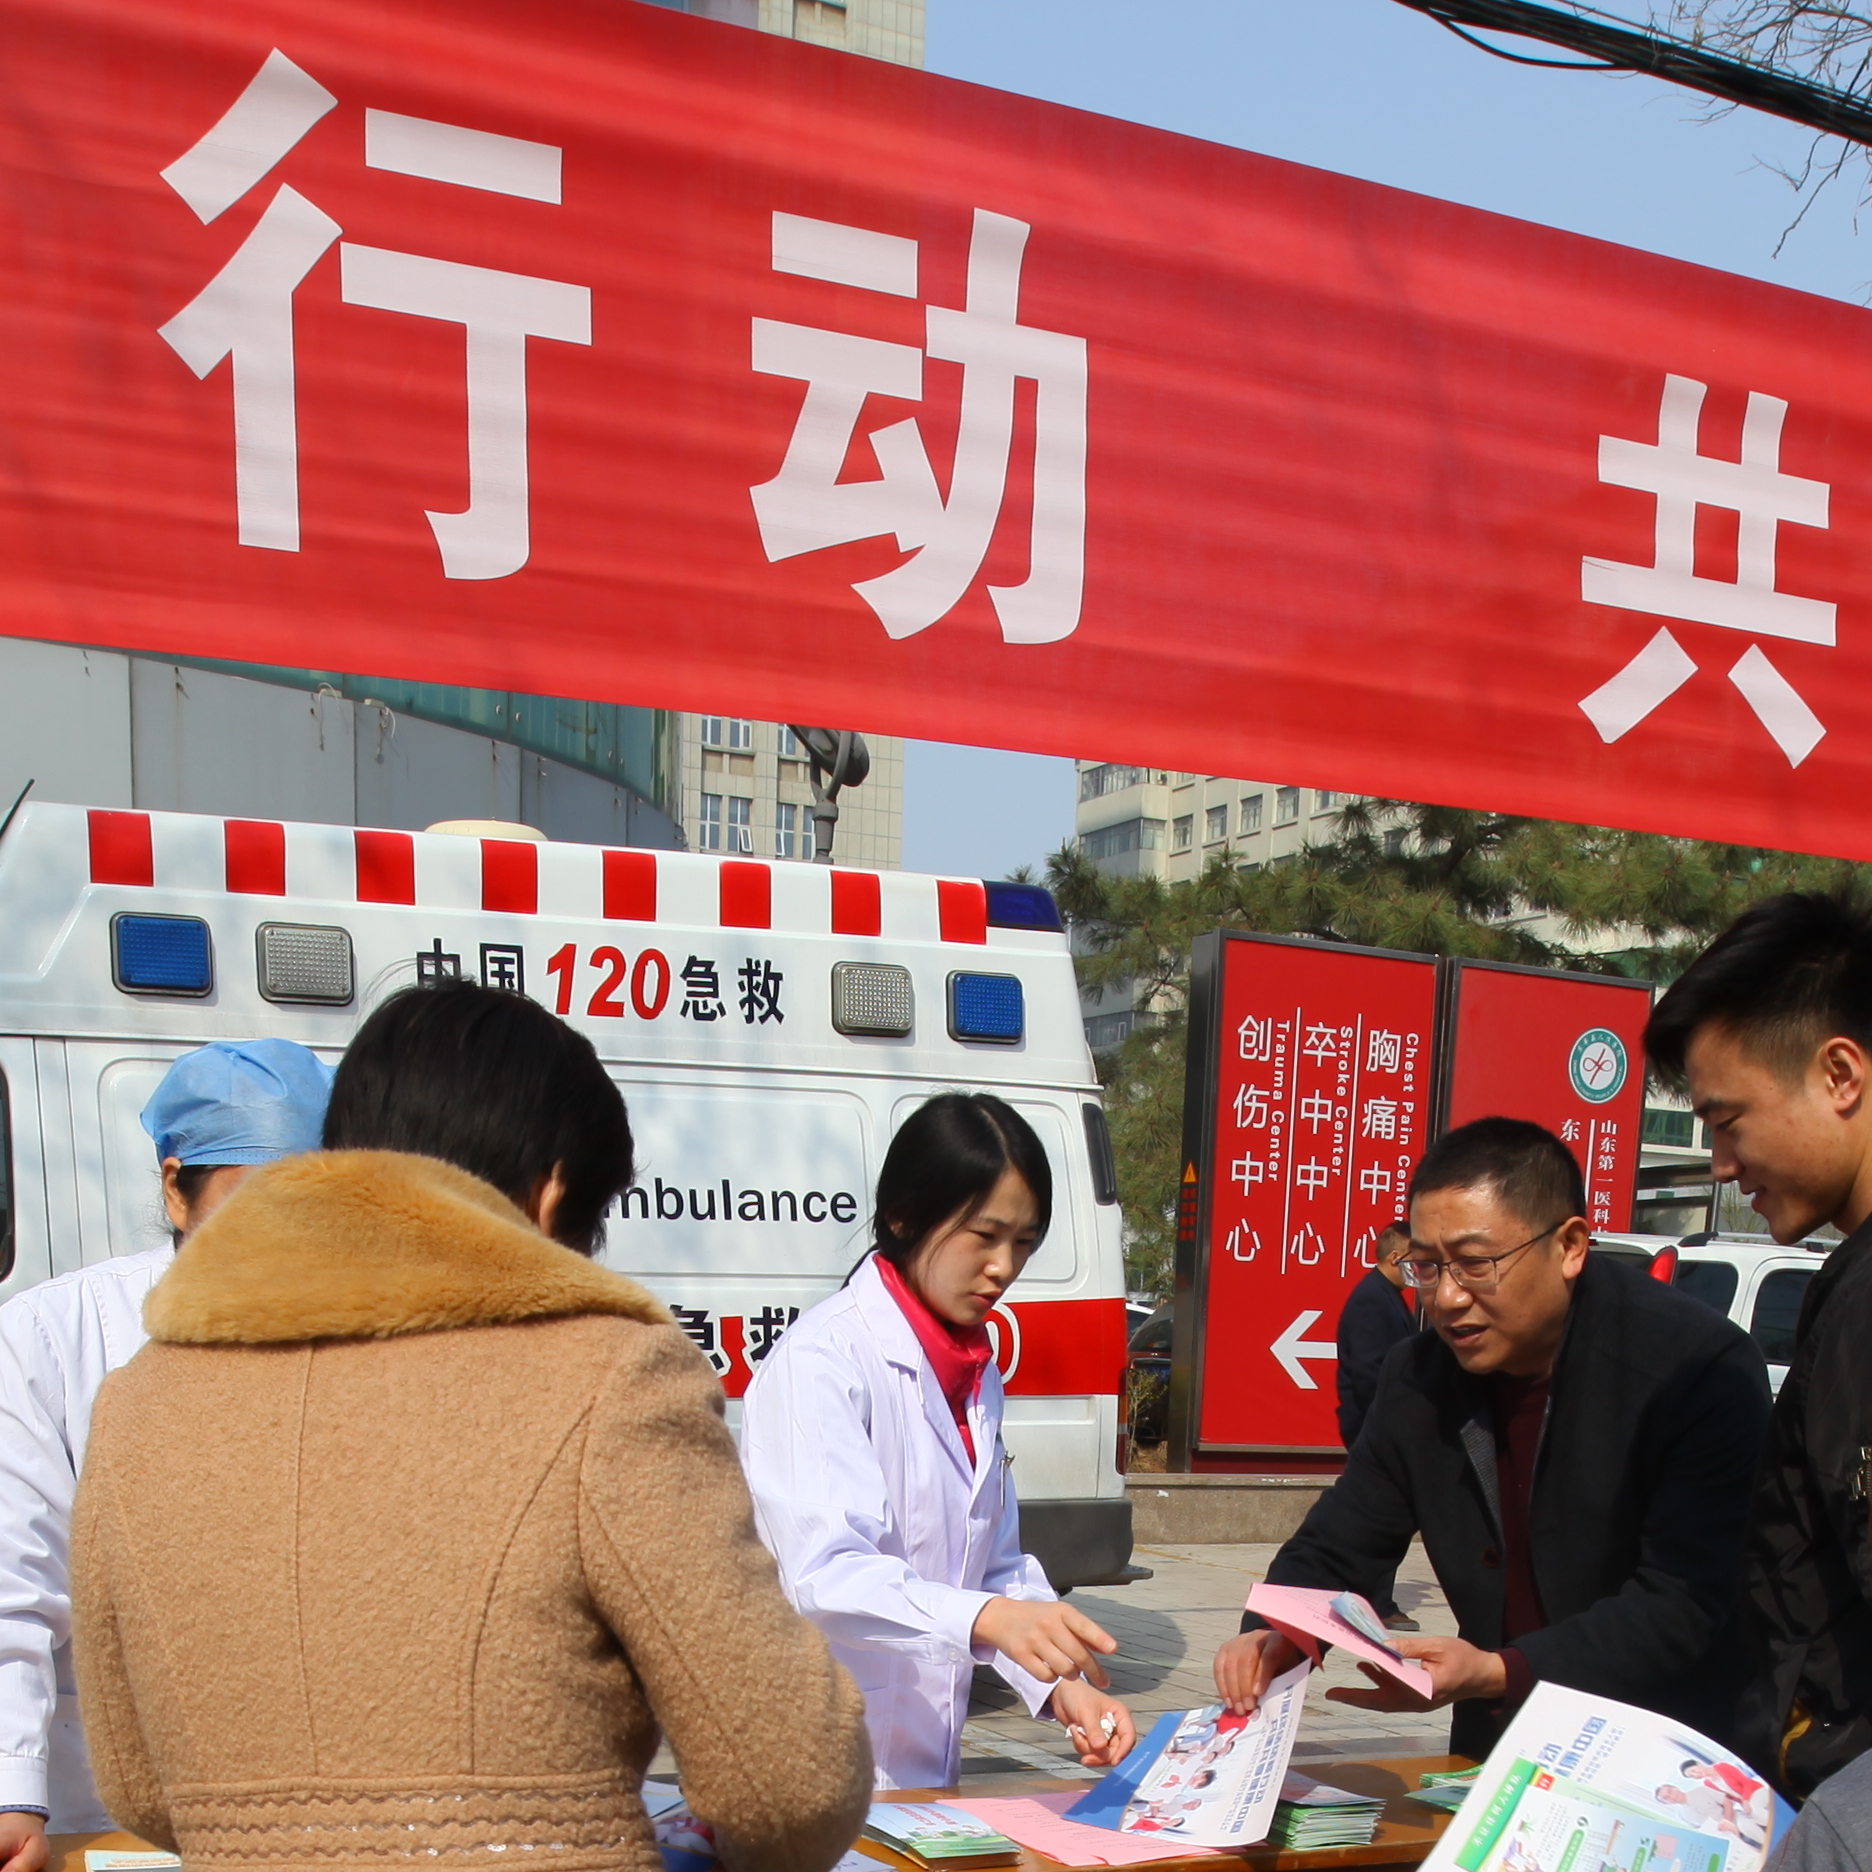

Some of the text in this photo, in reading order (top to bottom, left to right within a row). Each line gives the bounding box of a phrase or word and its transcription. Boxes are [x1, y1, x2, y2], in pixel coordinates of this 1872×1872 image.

[1226, 1015, 1272, 1262] 创伤中心
[1268, 1020, 1290, 1181] Trauma Center
[1290, 1022, 1337, 1265] 卒中中心
[1331, 1026, 1353, 1176] Stroke Center
[1353, 1029, 1401, 1269] 胸痛中心
[1394, 1033, 1419, 1222] Chest Pain Center
[1593, 1119, 1618, 1233] 山东第一医科
[603, 1177, 858, 1223] mbulance
